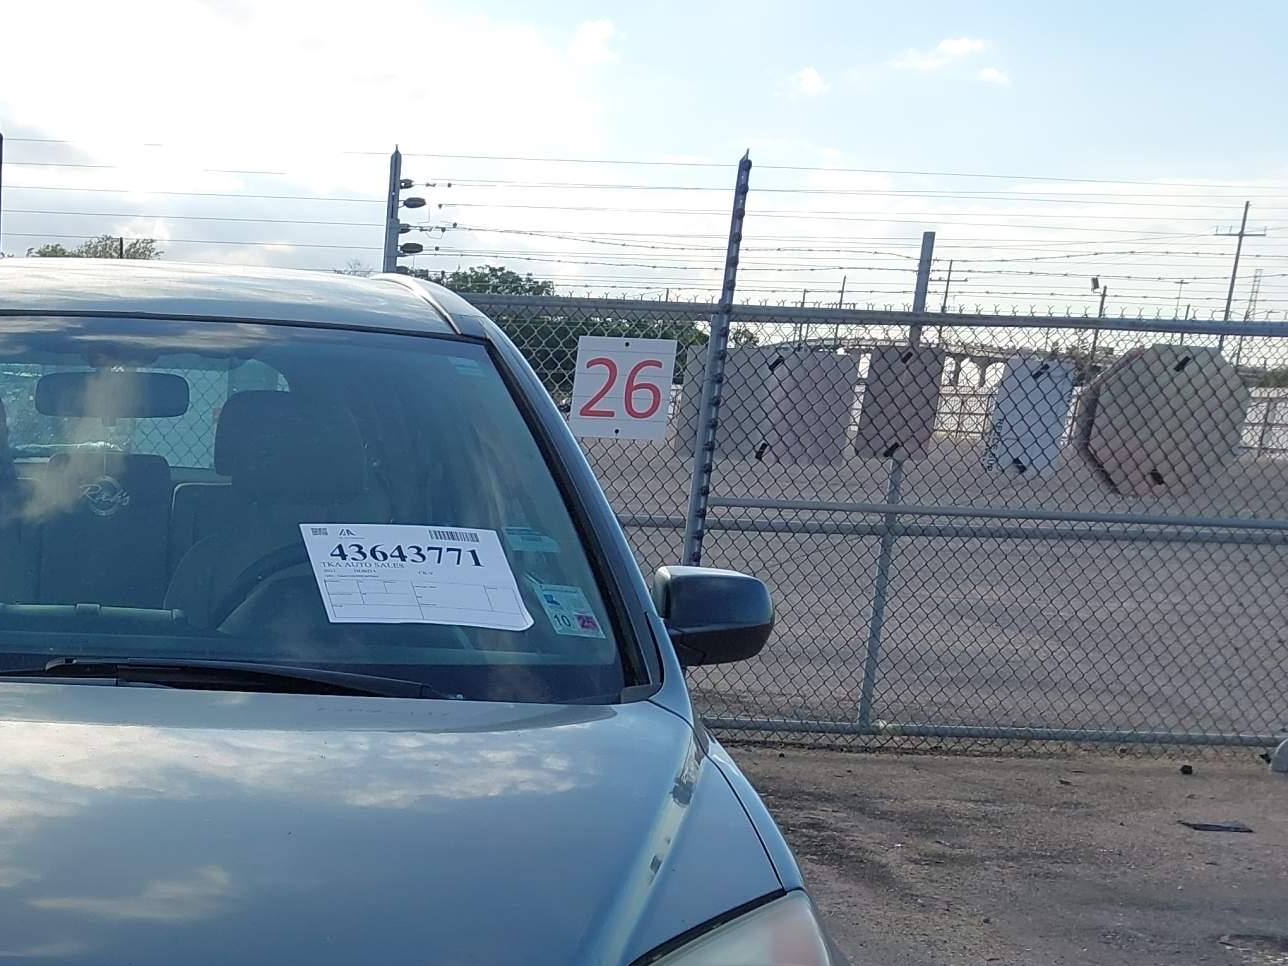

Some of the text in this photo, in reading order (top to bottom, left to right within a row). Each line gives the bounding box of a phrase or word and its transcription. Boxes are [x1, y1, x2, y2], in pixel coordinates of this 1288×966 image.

[579, 357, 663, 420] 26
[330, 543, 486, 568] 43643771
[553, 614, 571, 627] 10
